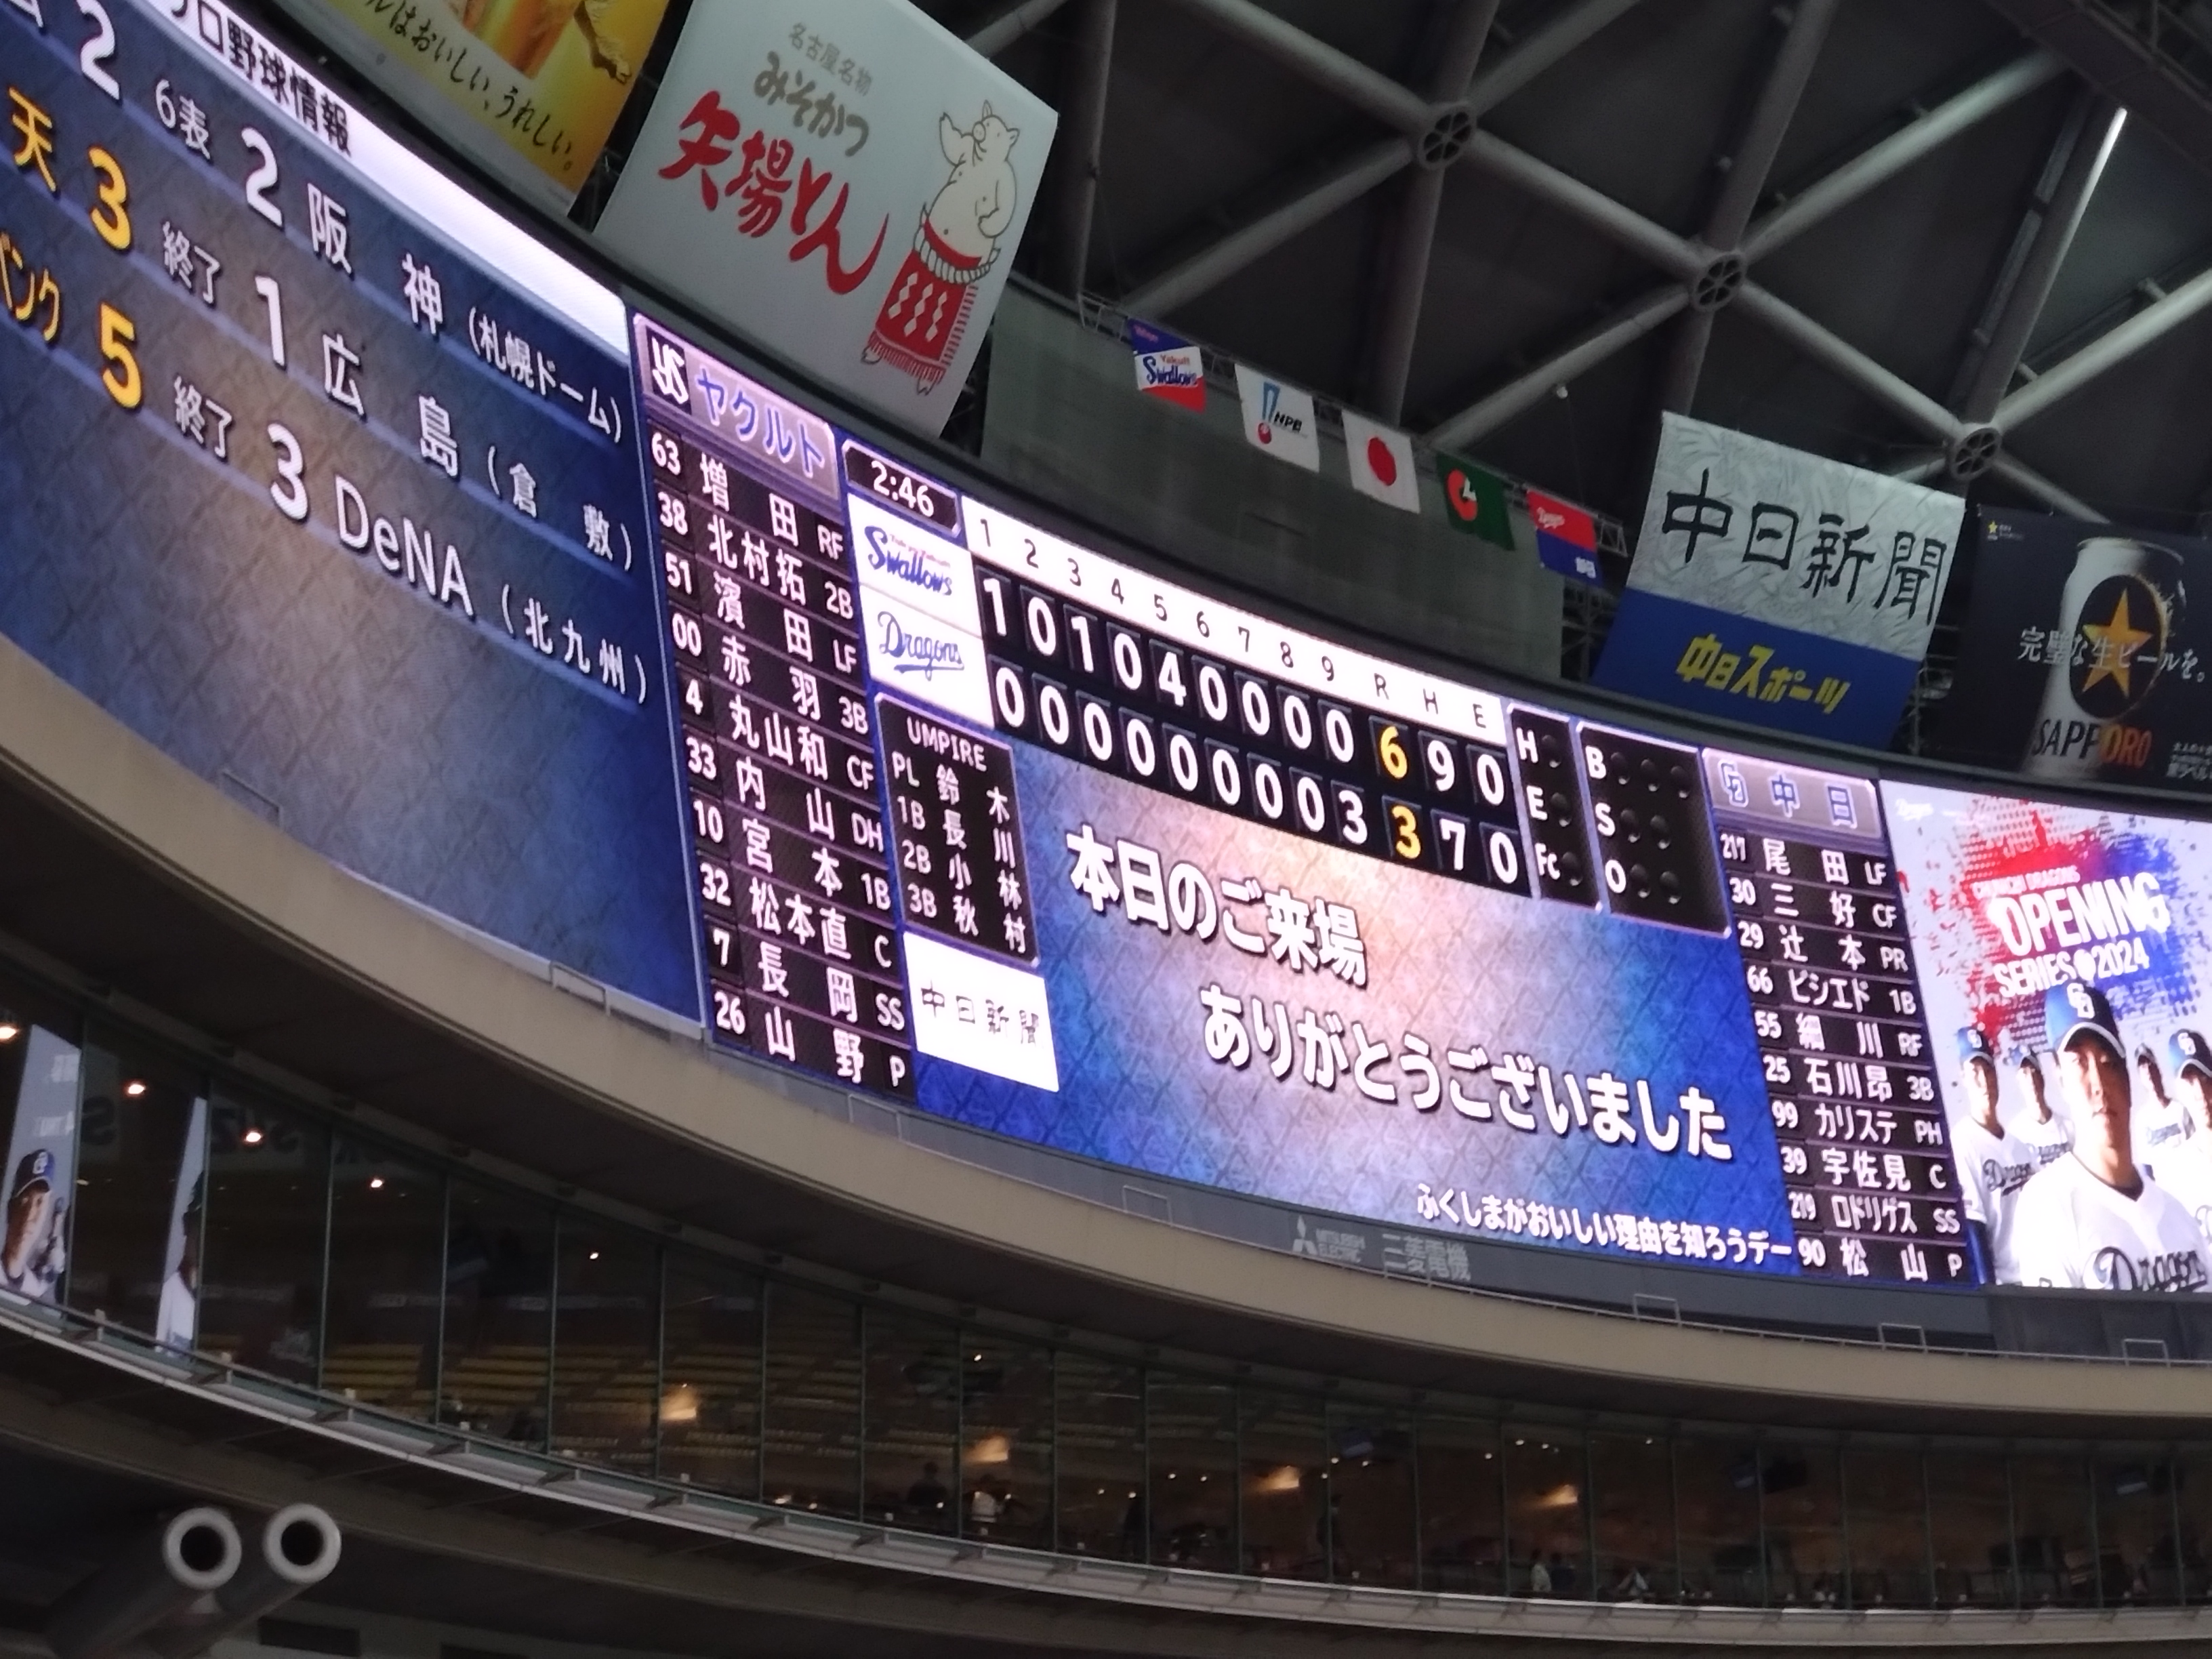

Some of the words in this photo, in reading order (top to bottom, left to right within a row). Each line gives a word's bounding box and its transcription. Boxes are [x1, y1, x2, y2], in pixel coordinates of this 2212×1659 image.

[171, 0, 351, 157] ロ野球情報
[788, 22, 872, 96] 名古屋名物
[76, 0, 120, 100] 2
[156, 79, 210, 159] 6表
[242, 127, 283, 227] 2
[754, 52, 868, 157] みそかつ
[658, 90, 890, 295] 矢場とん
[89, 148, 130, 249] 3
[162, 222, 220, 304] 終了
[256, 277, 285, 367] 1
[695, 366, 825, 477] ヤクルト
[1274, 411, 1302, 432] NPB
[101, 303, 141, 407] 5
[174, 376, 232, 459] 終了
[269, 423, 307, 520] 3
[336, 476, 474, 616] DeNA
[651, 432, 680, 475] 63
[818, 525, 843, 559] RF
[872, 460, 934, 517] 2:46
[659, 491, 688, 535] 38
[708, 515, 806, 605] 北村拓
[825, 581, 853, 619] 2B
[865, 525, 952, 596] Swallows
[1662, 468, 1947, 626] 中日新聞
[665, 552, 692, 594] 51
[834, 639, 857, 673] LF
[878, 611, 964, 680] Dragons
[981, 518, 991, 547] 1
[1025, 539, 1039, 569] 2
[1067, 558, 1082, 586] 3
[1111, 578, 1124, 605] 4
[1154, 594, 1168, 621] 5
[1197, 611, 1210, 638] 6
[1237, 627, 1250, 653] 7
[1280, 642, 1294, 668] 8
[1322, 656, 1334, 682] 9
[1374, 673, 1389, 700] R
[1424, 689, 1439, 715] H
[1473, 703, 1487, 729] E
[673, 613, 702, 656] 00
[840, 696, 868, 735] 3B
[983, 578, 1006, 636] 1
[1028, 596, 1056, 656] 0
[1071, 616, 1094, 673] 1
[1114, 632, 1143, 691] 0
[1158, 652, 1187, 708] 4
[1200, 665, 1227, 721] 0
[1242, 680, 1271, 736] 0
[1284, 695, 1312, 750] 0
[1326, 709, 1354, 762] 0
[1380, 726, 1408, 780] 6
[1427, 740, 1455, 792] 9
[1476, 754, 1504, 805] 0
[1676, 634, 1851, 714] 中日スポーツ
[686, 679, 703, 714] 4
[731, 695, 828, 781] 丸山和
[847, 756, 874, 790] CF
[892, 752, 920, 787] PL
[907, 716, 987, 772] UMPIRE
[1516, 727, 1538, 763] H
[1586, 745, 1607, 779] B
[2032, 718, 2152, 769] SAPPORO
[686, 737, 717, 780] 33
[853, 813, 883, 852] DH
[996, 667, 1025, 727] 0
[1040, 685, 1069, 745] 0
[1084, 703, 1113, 761] 0
[1126, 718, 1155, 777] 0
[1170, 735, 1198, 792] 0
[1212, 749, 1241, 806] 0
[1255, 763, 1283, 819] 0
[1297, 777, 1325, 833] 0
[1338, 790, 1368, 844] 3
[1391, 806, 1421, 859] 3
[1440, 819, 1465, 871] 7
[1490, 832, 1518, 884] 0
[1526, 785, 1548, 821] E
[897, 796, 925, 830] 1B
[1595, 802, 1616, 836] S
[693, 800, 723, 842] 10
[861, 873, 890, 911] 1B
[902, 840, 931, 874] 2B
[1864, 861, 1887, 885] LF
[700, 863, 731, 906] 32
[750, 877, 851, 960] 松本直
[876, 935, 891, 968] C
[907, 883, 937, 918] 3B
[1066, 824, 1367, 987] 本日のご来場
[1729, 878, 1757, 906] 30
[1872, 904, 1898, 928] CF
[1989, 872, 2170, 956] OPENING
[714, 930, 729, 966] 7
[876, 994, 904, 1031] SS
[1738, 921, 1763, 949] 29
[1880, 946, 1908, 972] PR
[1993, 949, 2076, 998] SERIES
[2093, 938, 2150, 979] 2024
[1746, 966, 1774, 995] 66
[1788, 968, 1870, 1012] ビシエド
[1889, 989, 1917, 1015] 1B
[1754, 1011, 1782, 1039] 55
[715, 991, 745, 1035] 26
[890, 1057, 905, 1086] P
[1200, 985, 1732, 1159] ありがとうございました
[1763, 1055, 1791, 1084] 25
[1906, 1076, 1935, 1101] 3B
[1771, 1101, 1799, 1129] 99
[1815, 1102, 1897, 1145] カリステ
[1914, 1120, 1943, 1145] PH
[1780, 1147, 1808, 1174] 39
[1821, 1147, 1911, 1192] 宇佐見
[1929, 1164, 1946, 1189] C
[1417, 1183, 1792, 1263] ふくしまがおいしい理由を知ろうデー
[1831, 1194, 1917, 1233] ロドリゲス
[1933, 1208, 1961, 1234] SS
[1382, 1234, 1471, 1281] 三菱電機
[1798, 1238, 1826, 1267] 90
[1947, 1253, 1963, 1277] P
